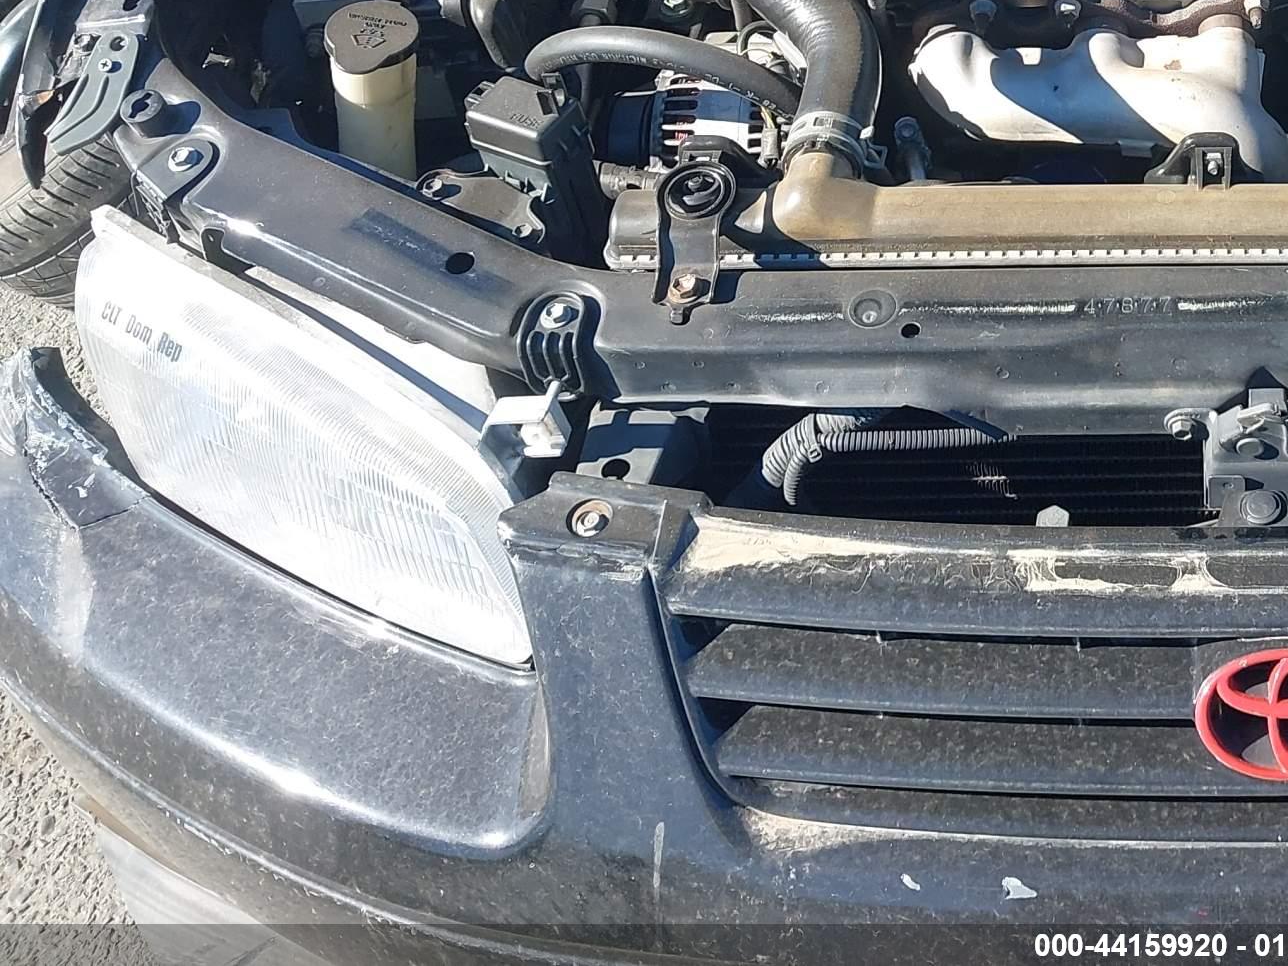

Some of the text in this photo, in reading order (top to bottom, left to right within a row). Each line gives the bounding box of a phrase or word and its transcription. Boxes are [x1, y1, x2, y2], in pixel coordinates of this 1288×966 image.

[101, 300, 183, 362] CLT Dom Rep
